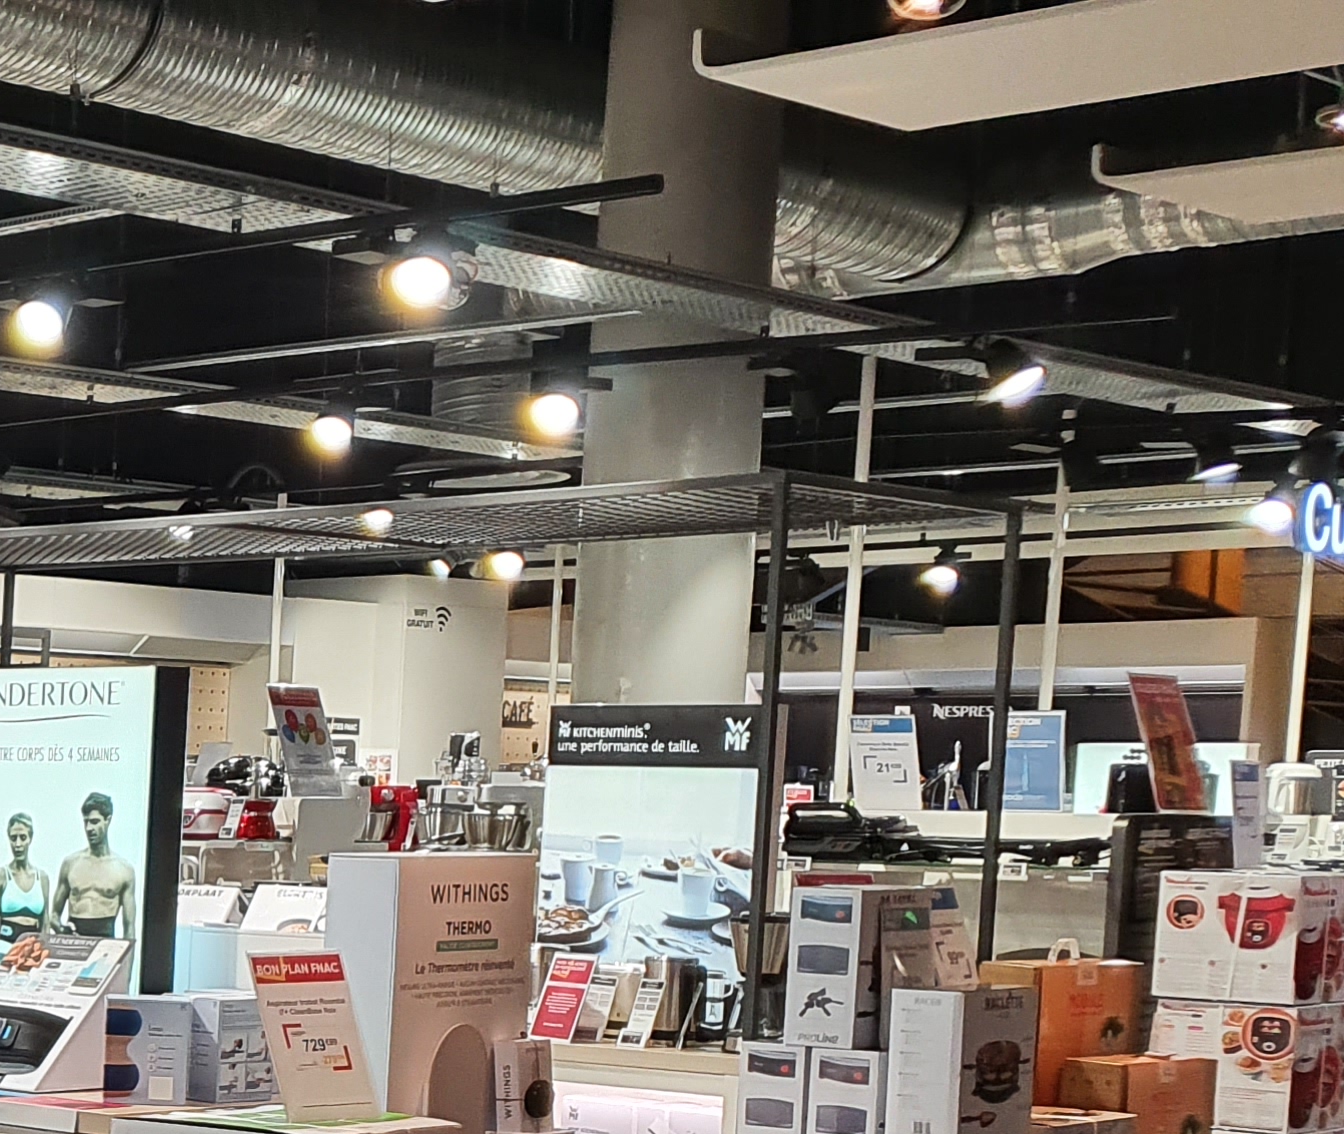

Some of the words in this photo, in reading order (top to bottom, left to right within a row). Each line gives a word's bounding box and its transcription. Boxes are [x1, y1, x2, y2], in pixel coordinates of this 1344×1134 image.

[406, 618, 434, 629] GRATUIT
[502, 694, 535, 724] CAFÉ
[931, 703, 1013, 720] NESPRES
[724, 716, 752, 751] WMF
[16, 747, 45, 762] CORPS
[47, 743, 64, 762] DÈS
[67, 747, 74, 763] 4
[76, 746, 120, 762] SEMAINES
[557, 740, 578, 752] une
[580, 738, 649, 755] performance
[651, 739, 665, 753] de
[668, 739, 700, 754] taille.
[430, 882, 510, 905] WITHINGS
[445, 919, 493, 937] THERMO
[255, 964, 280, 976] BON
[282, 963, 309, 975] PLAN
[310, 962, 340, 975] FNAC
